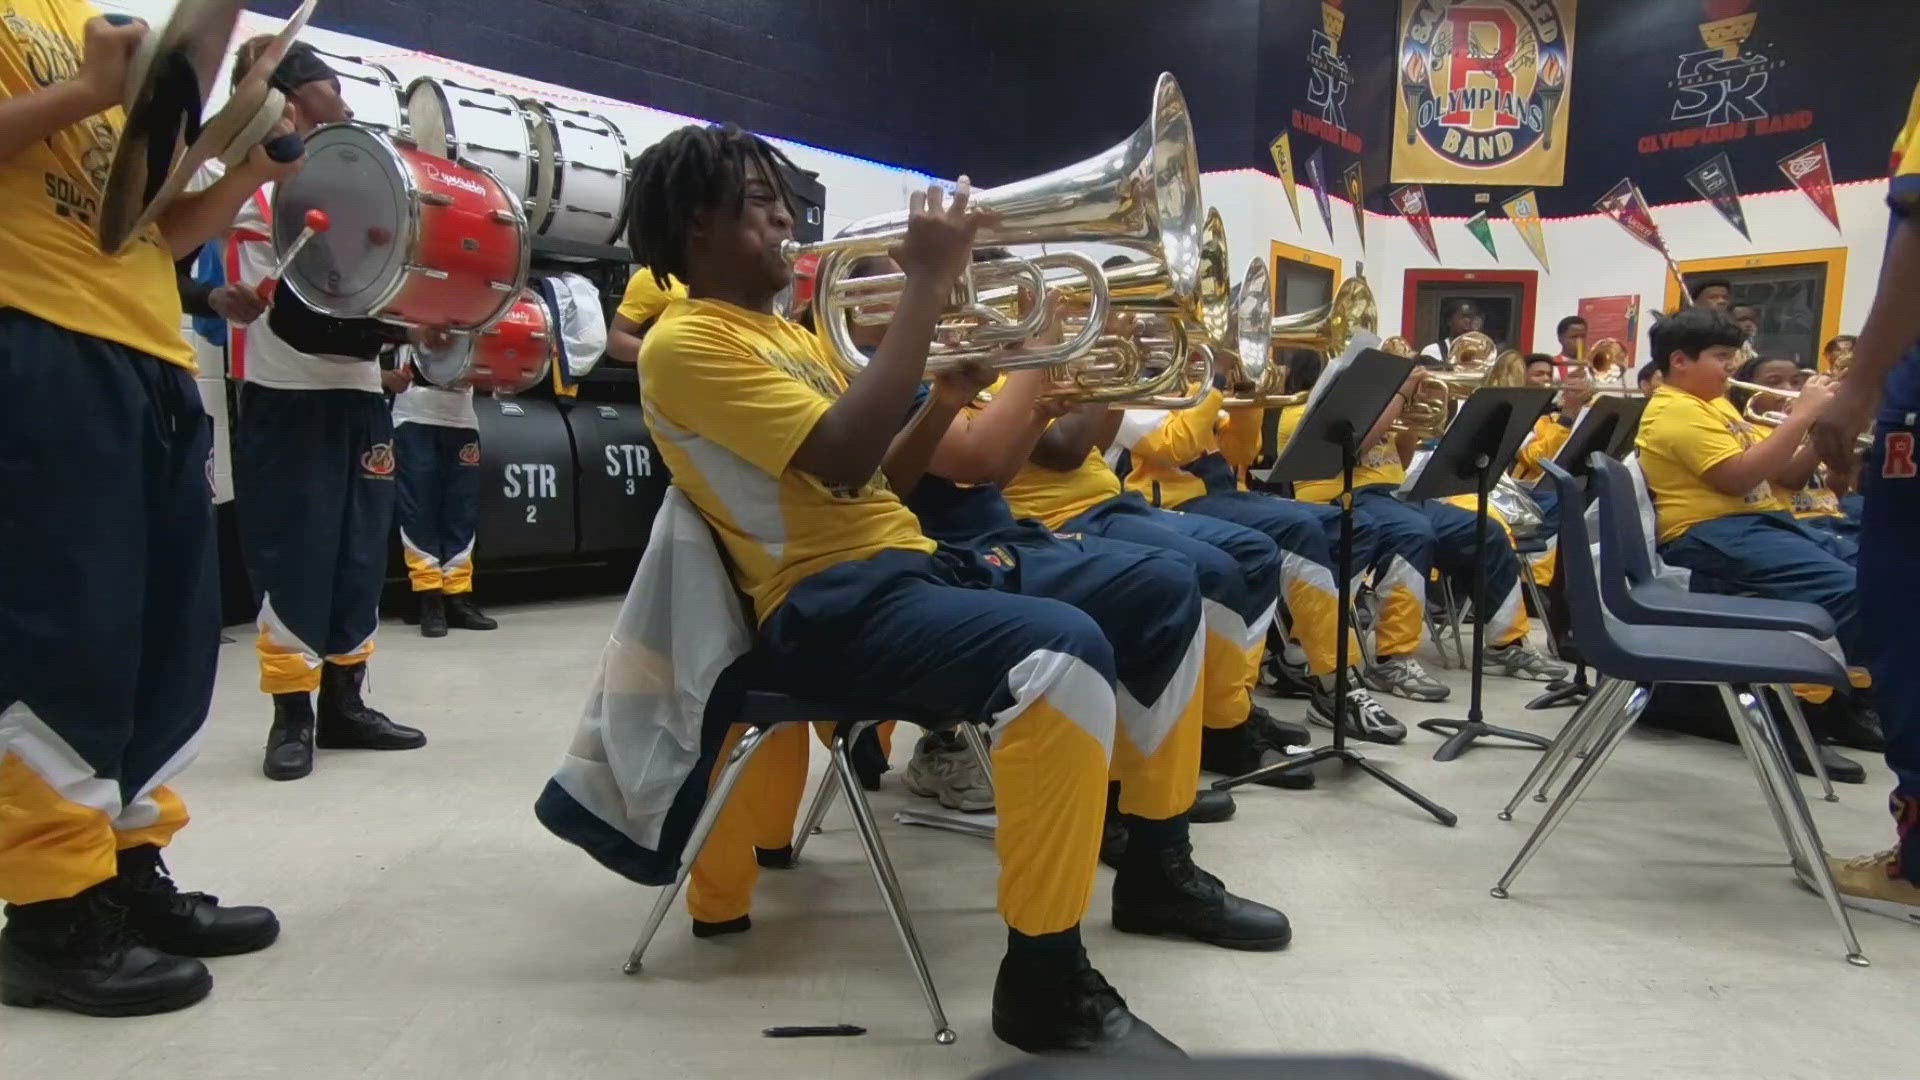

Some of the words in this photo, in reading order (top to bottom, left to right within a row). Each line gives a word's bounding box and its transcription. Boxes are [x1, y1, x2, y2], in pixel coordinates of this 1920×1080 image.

[1439, 6, 1521, 128] R
[1418, 87, 1543, 132] OLYMPIANS
[1442, 128, 1514, 161] BAND
[605, 444, 651, 477] STR
[1882, 432, 1917, 479] R
[503, 463, 558, 499] STR
[625, 478, 636, 496] 3
[525, 504, 537, 523] 2
